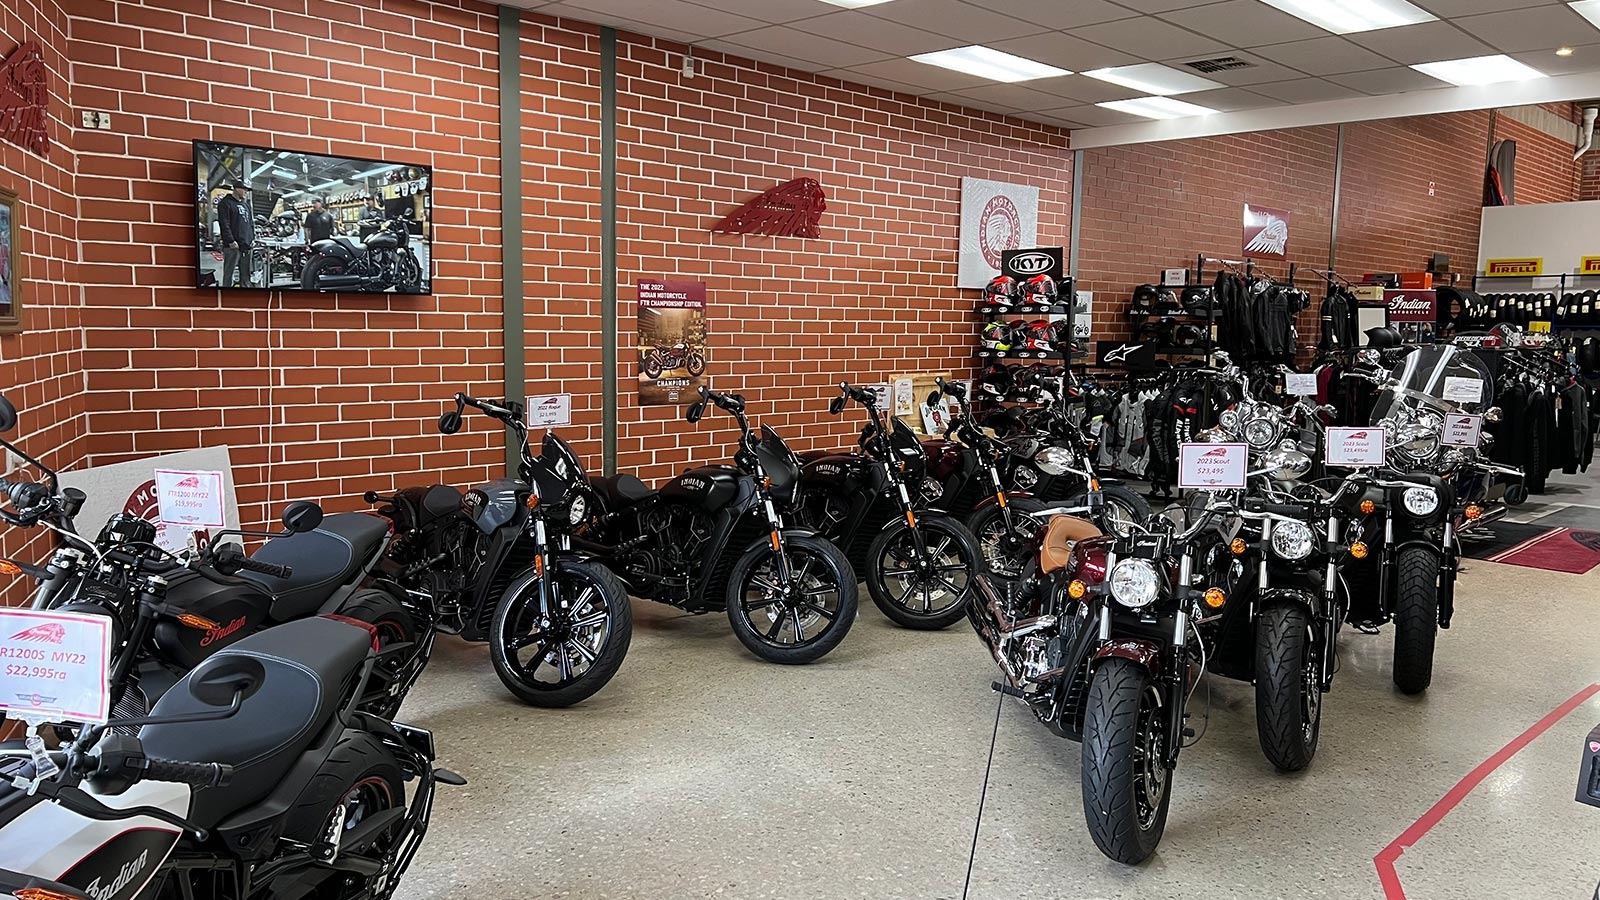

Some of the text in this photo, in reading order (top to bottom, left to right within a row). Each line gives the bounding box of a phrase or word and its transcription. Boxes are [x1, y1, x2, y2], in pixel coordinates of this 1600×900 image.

[1014, 257, 1050, 271] KYT
[1490, 262, 1537, 274] PIRELLI
[639, 283, 665, 292] THE 2022
[639, 291, 687, 301] INDIAN MOTORCYCLE
[651, 300, 685, 308] CHAMPIONSHIP
[1388, 295, 1432, 310] Indian
[656, 380, 690, 388] CHAMPIONS
[816, 464, 841, 474] INDIAN
[1197, 467, 1224, 475] $23,495
[681, 478, 706, 489] INDIAN
[168, 490, 191, 498] FTR1200
[200, 615, 247, 647] Indian
[51, 652, 87, 665] MY22
[6, 663, 67, 680] $22,995ra
[86, 849, 148, 900] Indian
